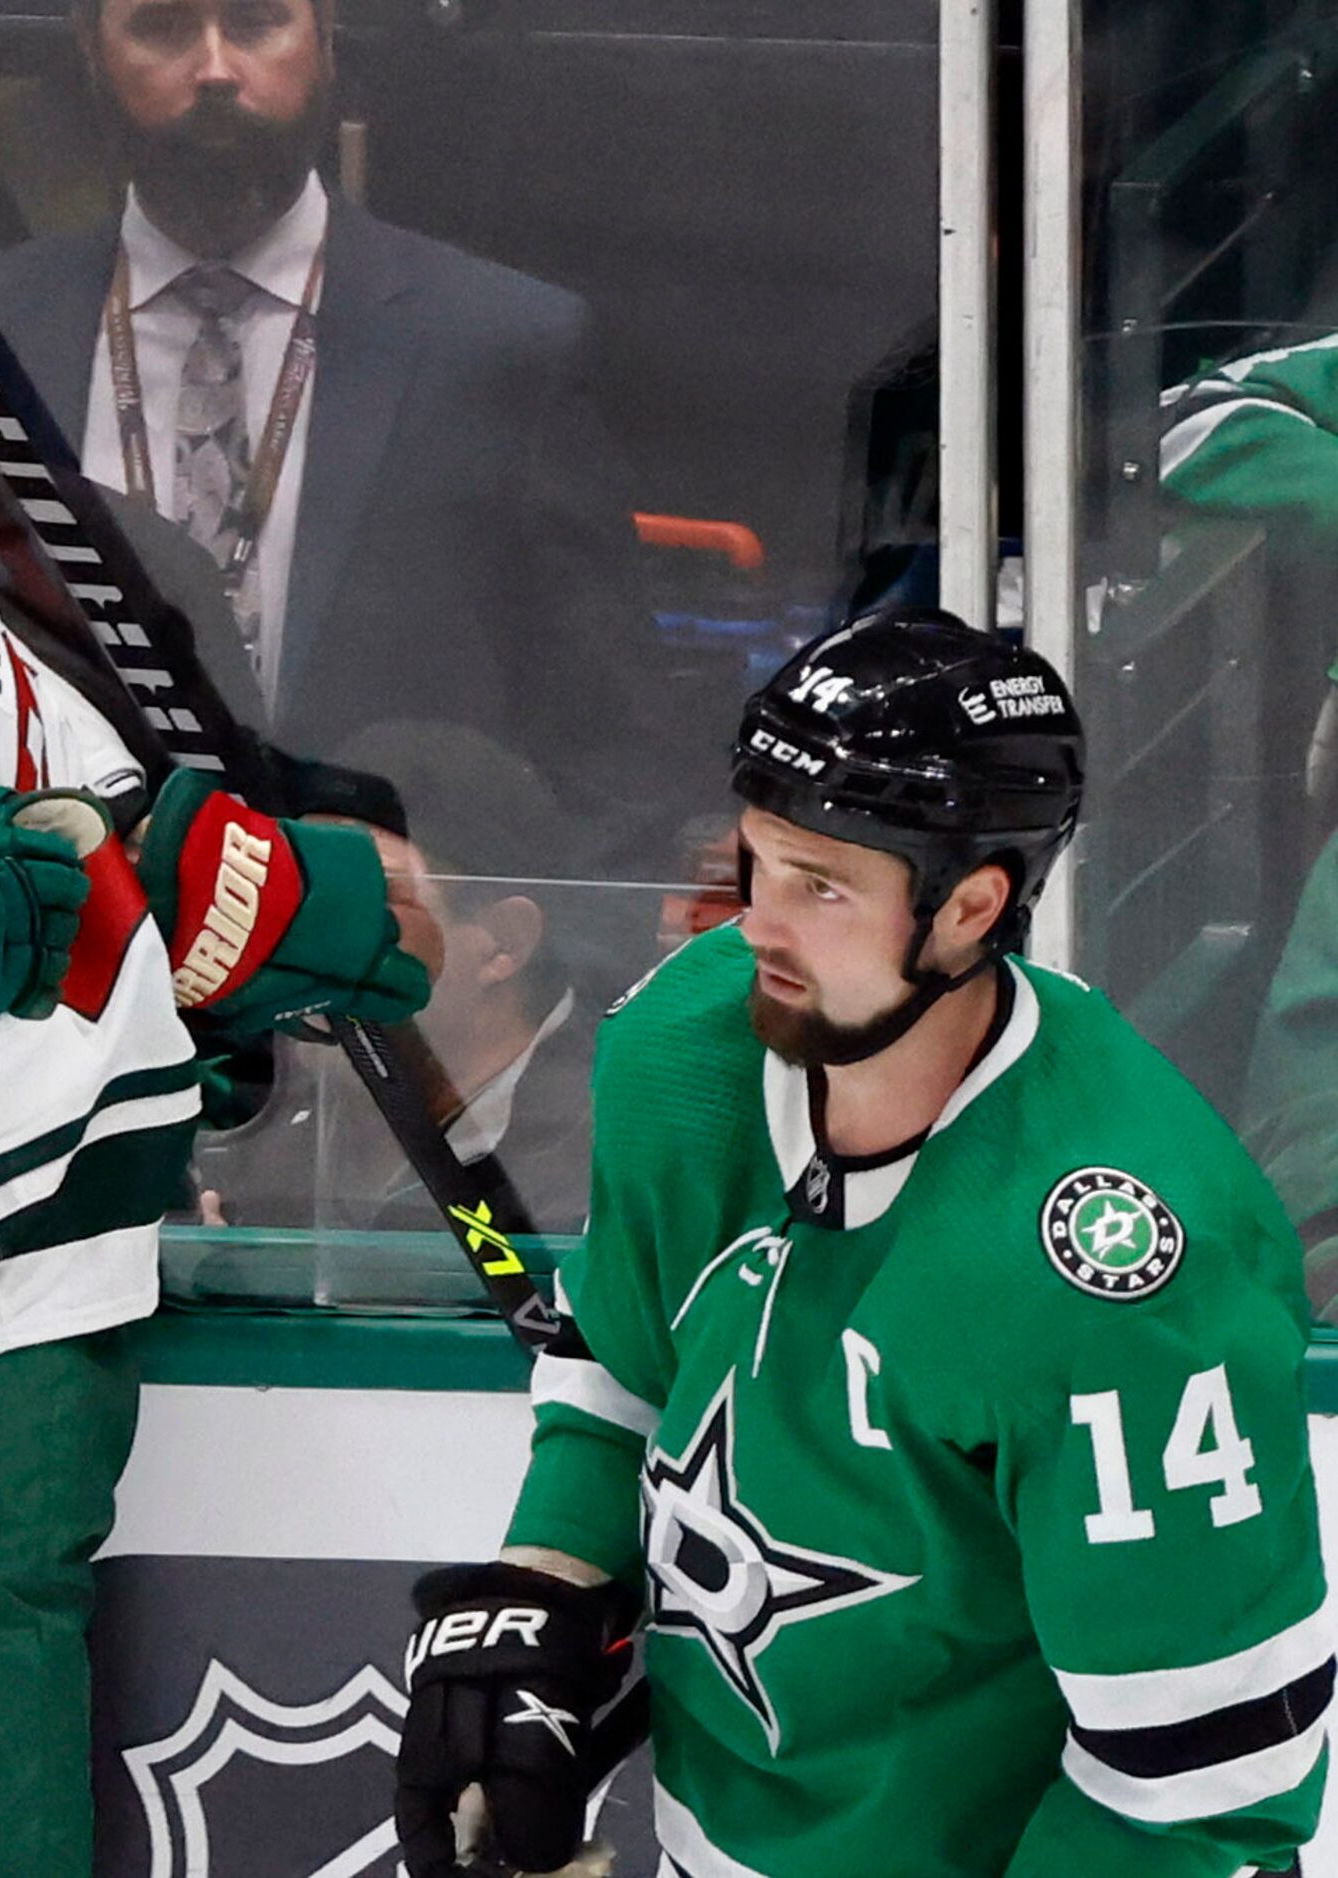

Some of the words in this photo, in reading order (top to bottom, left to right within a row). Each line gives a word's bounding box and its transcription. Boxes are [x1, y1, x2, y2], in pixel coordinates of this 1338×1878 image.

[787, 665, 854, 713] 14
[989, 675, 1045, 699] ENERGY
[996, 695, 1066, 719] TRANSFER
[750, 728, 827, 776] CCM
[1051, 1174, 1159, 1241] DALLAS
[1075, 1236, 1175, 1290] STARS
[1070, 1362, 1263, 1545] 14
